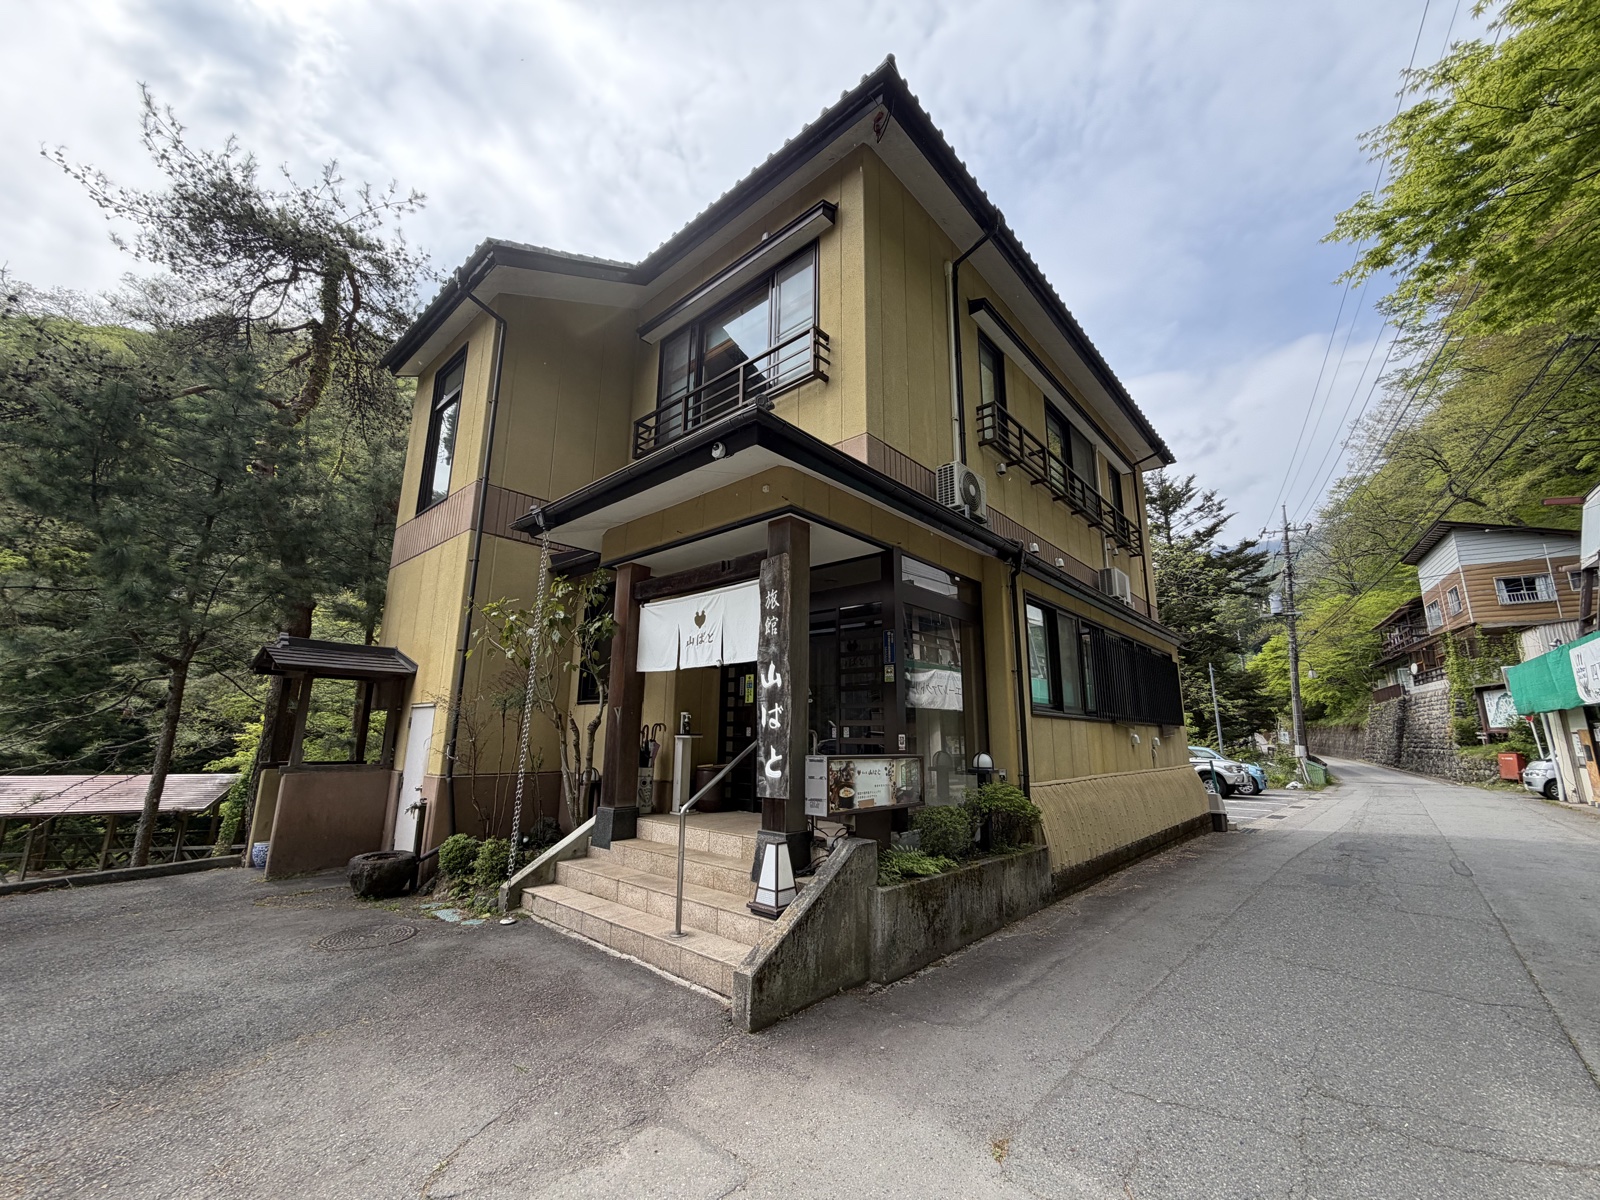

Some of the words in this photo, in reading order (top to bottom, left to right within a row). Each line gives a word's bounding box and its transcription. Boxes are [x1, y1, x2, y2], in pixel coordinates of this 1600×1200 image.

[765, 589, 780, 635] 旅館
[685, 631, 714, 647] 山ばと
[761, 660, 783, 779] 山ばと
